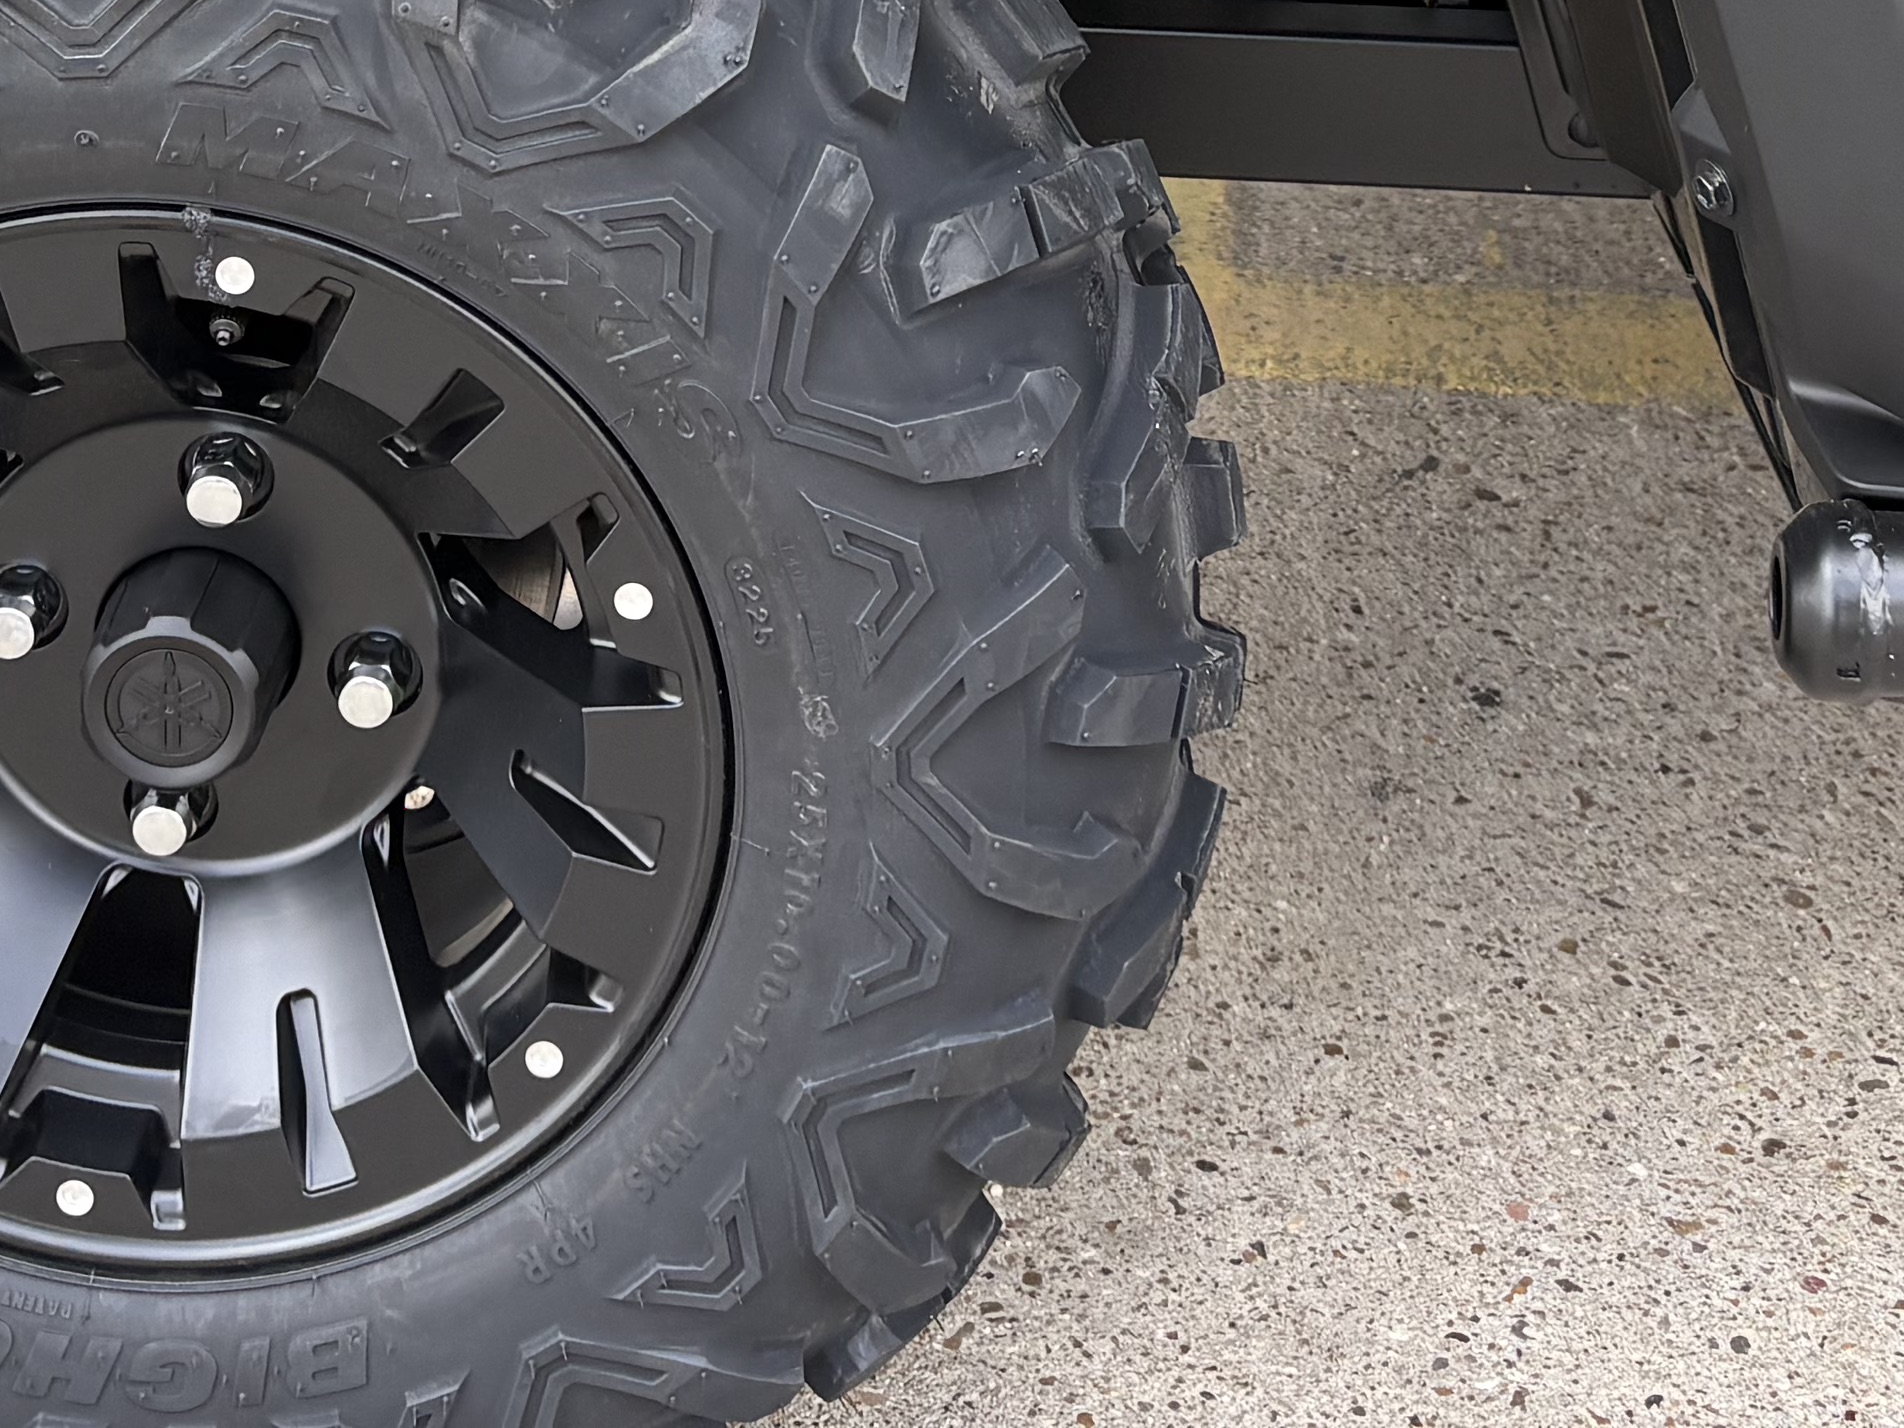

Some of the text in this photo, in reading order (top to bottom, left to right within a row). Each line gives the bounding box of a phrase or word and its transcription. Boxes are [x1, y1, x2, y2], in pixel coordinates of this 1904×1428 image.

[155, 101, 742, 468] MAXXIS
[624, 1116, 705, 1206] NHS
[514, 1209, 602, 1290] 4PR
[0, 1287, 73, 1321] PATENT
